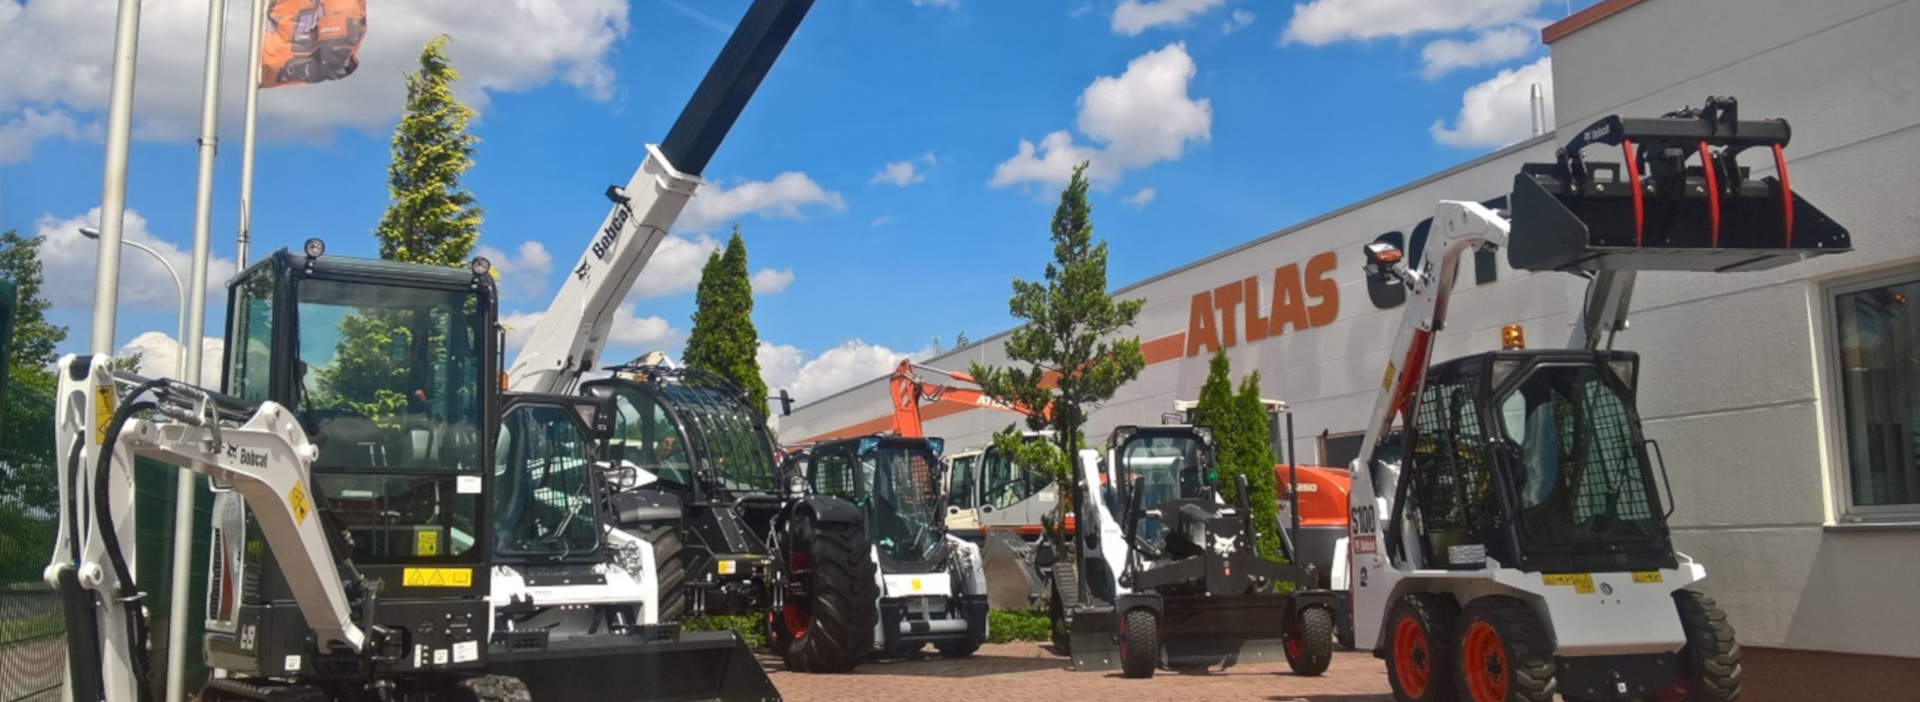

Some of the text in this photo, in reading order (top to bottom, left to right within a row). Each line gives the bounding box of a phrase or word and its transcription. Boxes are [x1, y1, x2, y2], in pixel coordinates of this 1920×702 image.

[592, 201, 632, 260] Bobcat
[1186, 250, 1341, 358] ATLAS
[240, 447, 268, 468] Bobcat
[1351, 505, 1376, 535] S100
